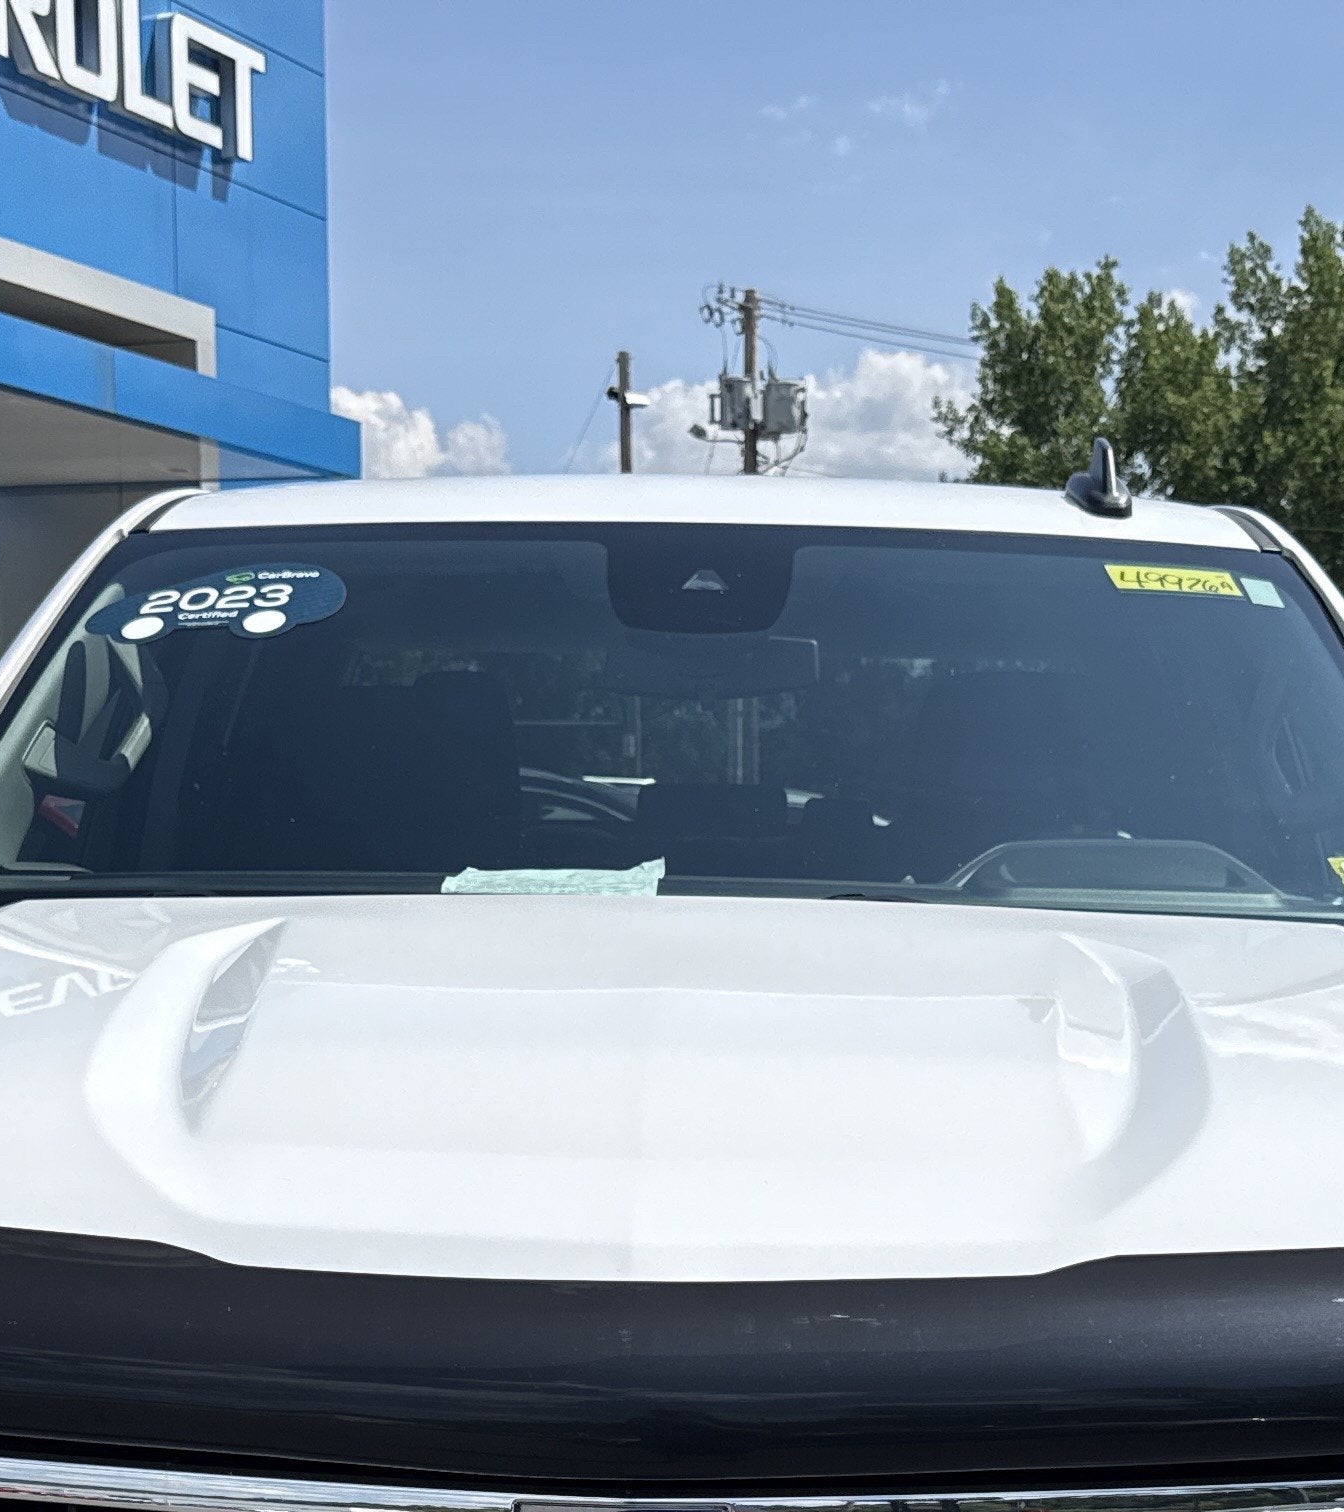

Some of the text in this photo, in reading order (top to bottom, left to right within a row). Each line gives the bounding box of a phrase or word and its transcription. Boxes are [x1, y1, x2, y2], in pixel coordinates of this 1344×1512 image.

[257, 569, 320, 580] CarBravo
[139, 584, 294, 614] 2023
[177, 610, 239, 620] Certified
